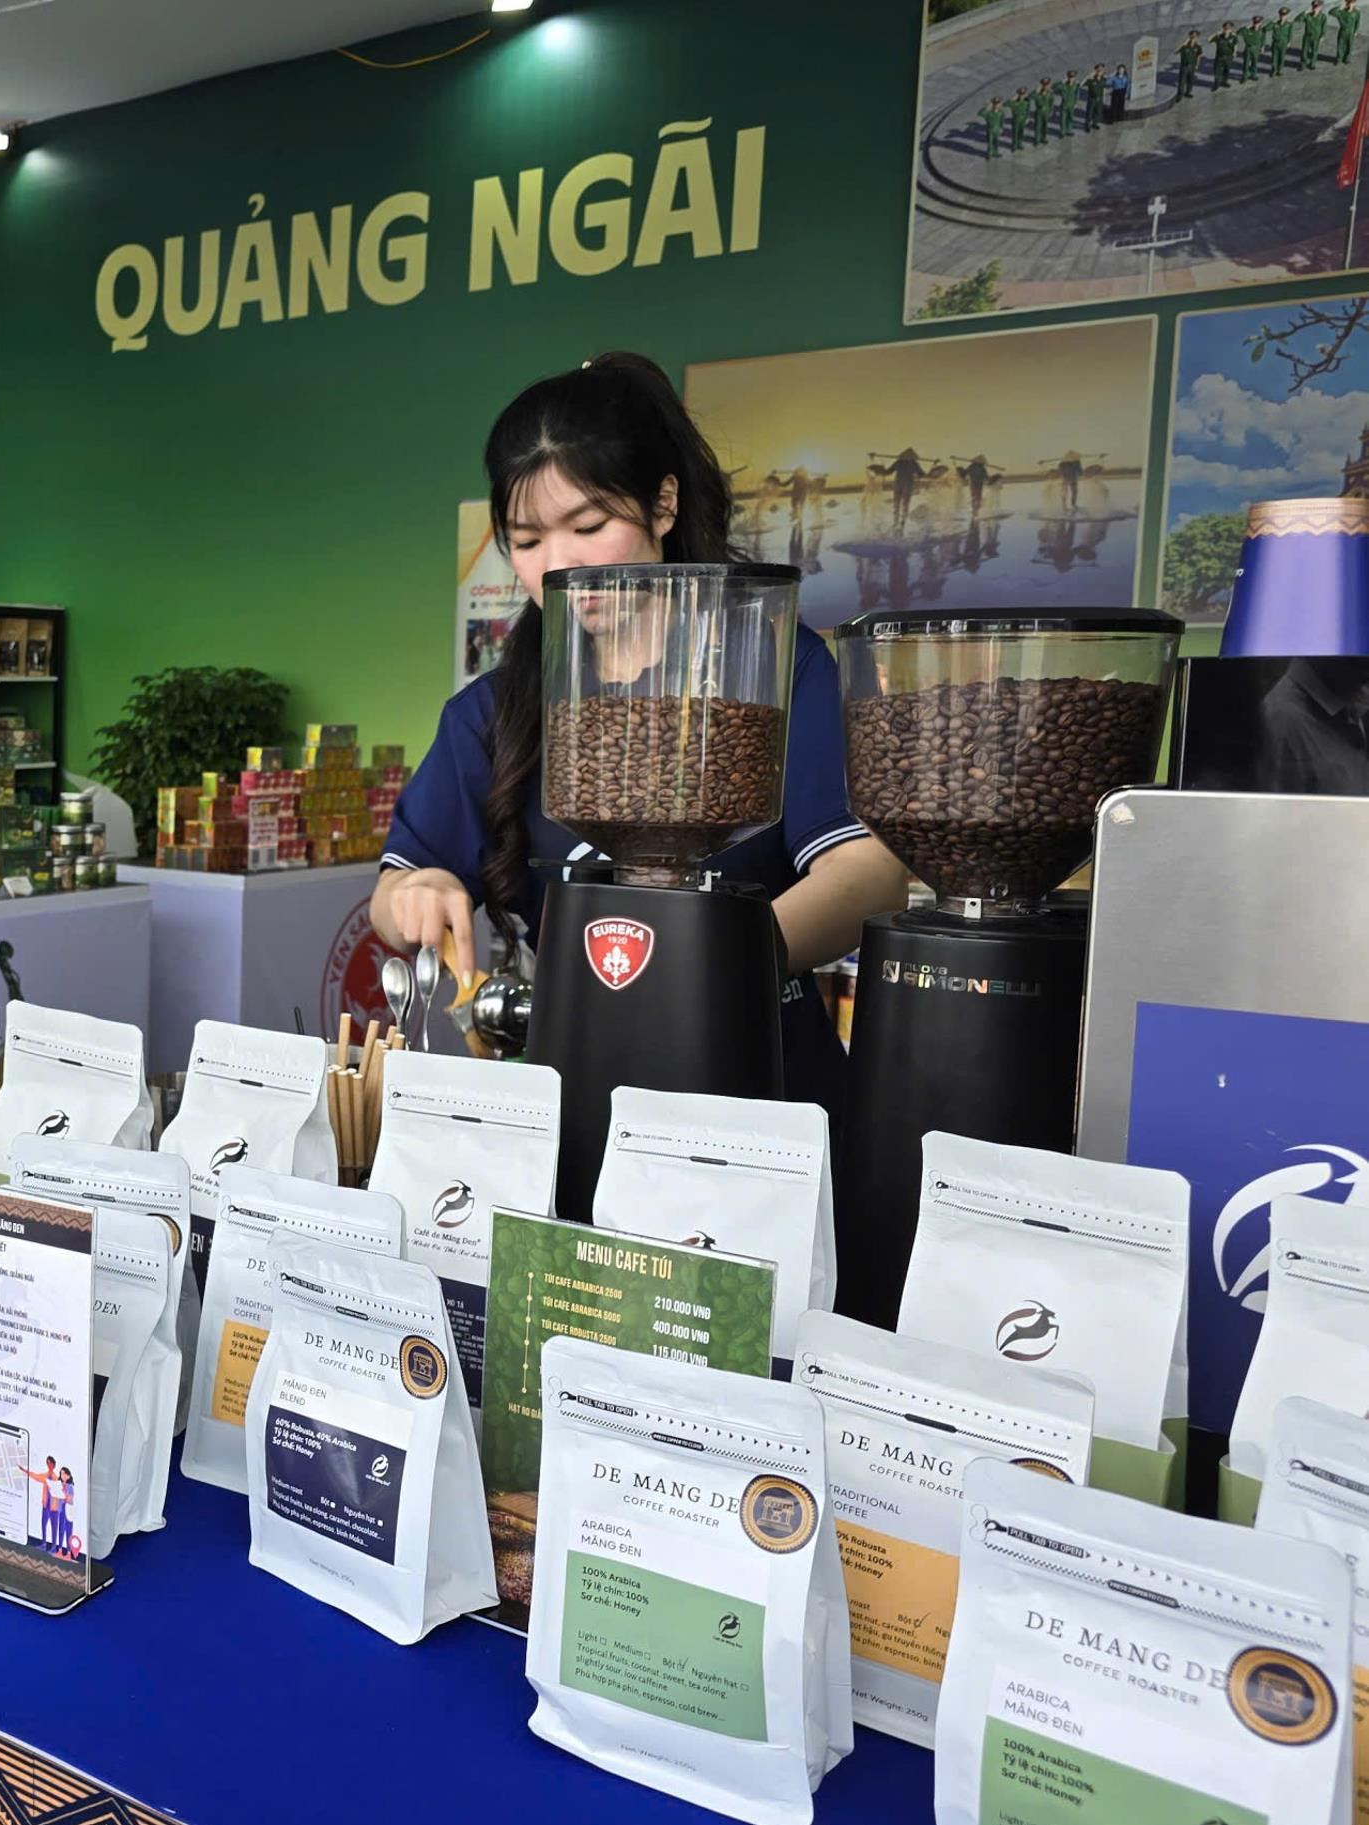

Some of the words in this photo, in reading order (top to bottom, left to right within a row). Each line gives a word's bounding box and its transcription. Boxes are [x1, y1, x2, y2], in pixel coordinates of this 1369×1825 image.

[96, 192, 430, 352] QUẢNG
[469, 117, 767, 293] NGÃI
[592, 924, 645, 941] EUREKA
[608, 936, 628, 944] 1920
[781, 976, 803, 1003] en
[247, 1258, 266, 1272] DE
[577, 1241, 612, 1266] MENU
[615, 1252, 647, 1275] CAFE
[651, 1256, 673, 1280] TÚI
[544, 1273, 555, 1284] TÚI
[555, 1276, 572, 1288] CAFE
[543, 1296, 553, 1307] TÚI
[554, 1299, 570, 1311] CAFE
[654, 1296, 691, 1315] 210.000
[233, 1308, 261, 1321] COFFEE
[541, 1319, 552, 1330] TÚI
[553, 1322, 568, 1334] CAFE
[652, 1320, 689, 1340] 400.000
[304, 1332, 323, 1348] DE
[330, 1338, 374, 1363] MANG
[380, 1353, 401, 1371] DE
[653, 1344, 688, 1363] 115.000
[319, 1356, 347, 1373] COFFEE
[351, 1365, 386, 1383] ROASTER
[280, 1391, 305, 1406] BLEND
[579, 1397, 593, 1406] PULL
[594, 1401, 605, 1409] TAB
[616, 1406, 632, 1415] OPEN
[276, 1417, 290, 1428] 60%
[316, 1432, 331, 1442] 40%
[332, 1437, 357, 1452] Arabica
[305, 1438, 321, 1450] 100%
[296, 1443, 314, 1459] Honey
[840, 1430, 871, 1452] DE
[881, 1442, 953, 1477] MANG
[592, 1463, 622, 1484] DE
[632, 1473, 701, 1503] MANG
[709, 1492, 741, 1514] DE
[869, 1463, 914, 1484] COFFEE
[919, 1478, 964, 1500] ROASTE
[623, 1495, 664, 1513] COFFEE
[669, 1506, 720, 1529] ROASTER
[832, 1500, 868, 1519] OFFEE
[581, 1519, 632, 1539] ARABICA
[581, 1533, 616, 1551] MĂNG
[618, 1542, 642, 1559] ĐEN
[851, 1536, 886, 1554] Robusta
[1010, 1528, 1029, 1541] PULL
[1031, 1535, 1046, 1546] TAB
[1048, 1540, 1058, 1550] TO
[1060, 1544, 1082, 1557] OPEN
[855, 1562, 883, 1579] Honey
[868, 1554, 893, 1569] 100%
[582, 1567, 607, 1579] 100%
[609, 1573, 640, 1589] Arabica
[581, 1592, 593, 1601] Sơ
[614, 1600, 641, 1617] Honey
[626, 1591, 649, 1605] 100%
[577, 1643, 608, 1658] Tropical
[578, 1630, 597, 1642] Light
[614, 1641, 643, 1657] Medium
[1025, 1610, 1064, 1638] DE
[1077, 1626, 1172, 1673] MANG
[1182, 1660, 1228, 1692] DE
[624, 1669, 637, 1680] low
[638, 1677, 668, 1691] caffeine
[1062, 1653, 1120, 1681] COFFEE
[1127, 1674, 1200, 1705] ROASTER
[852, 1688, 867, 1698] Net
[906, 1708, 929, 1722] 250g
[1006, 1682, 1071, 1712] ARABICA
[678, 1703, 695, 1713] cold
[1004, 1699, 1049, 1728] MĂNG
[1052, 1715, 1084, 1738] ĐEN
[1003, 1737, 1035, 1757] 100%
[1037, 1750, 1082, 1774] Arabica
[1061, 1773, 1095, 1794] 100%
[1045, 1785, 1082, 1806] Honey
